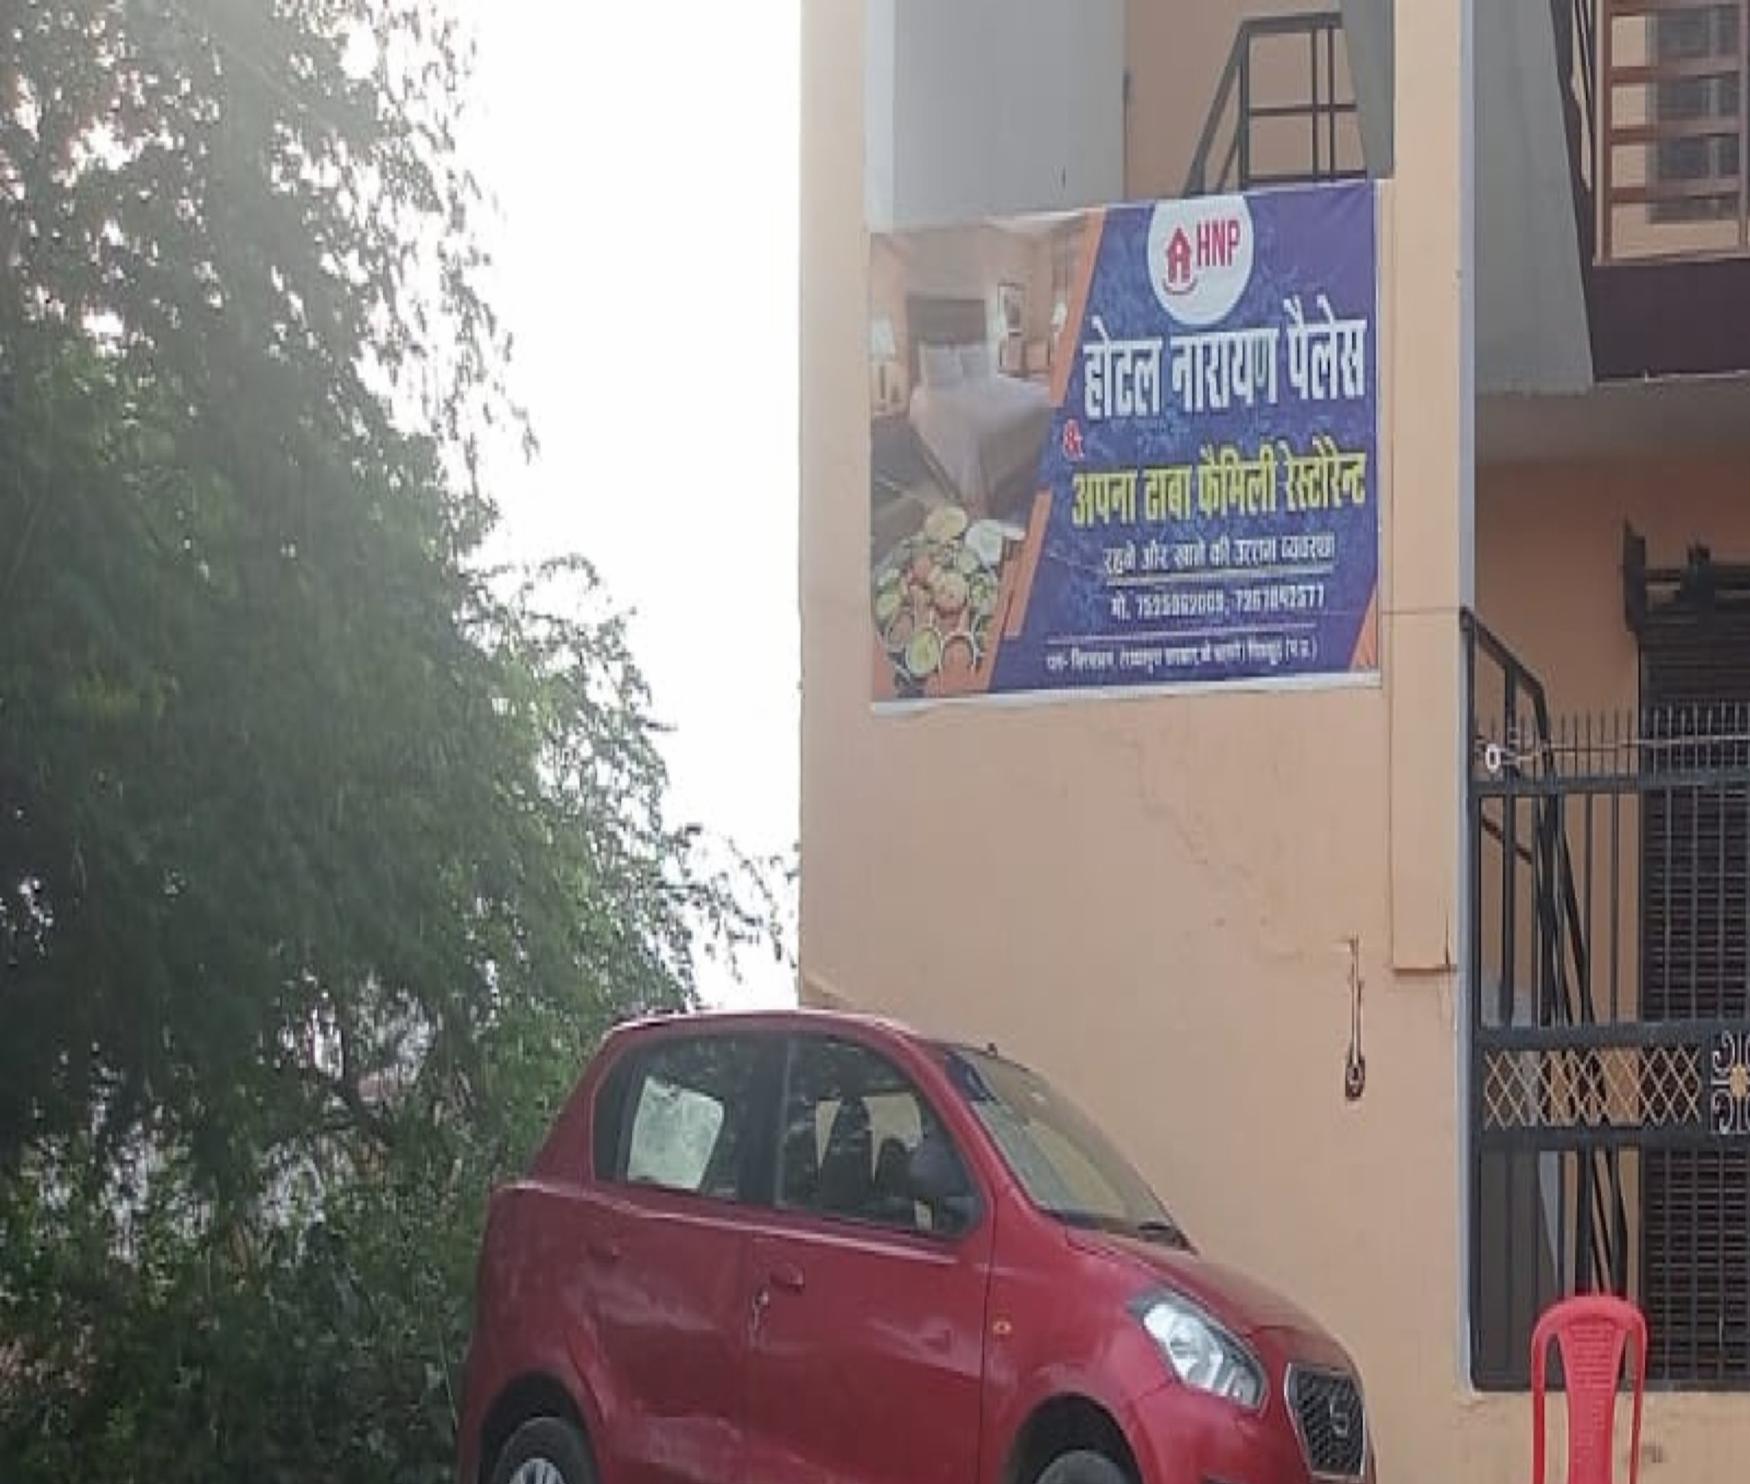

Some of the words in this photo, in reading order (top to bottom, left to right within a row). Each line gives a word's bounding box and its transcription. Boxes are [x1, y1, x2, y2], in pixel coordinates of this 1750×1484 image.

[1196, 219, 1240, 267] HNP
[1082, 315, 1162, 420] होटल
[1170, 327, 1279, 413] नारायण
[1282, 294, 1367, 401] पैलेस
[1072, 471, 1138, 525] अपना
